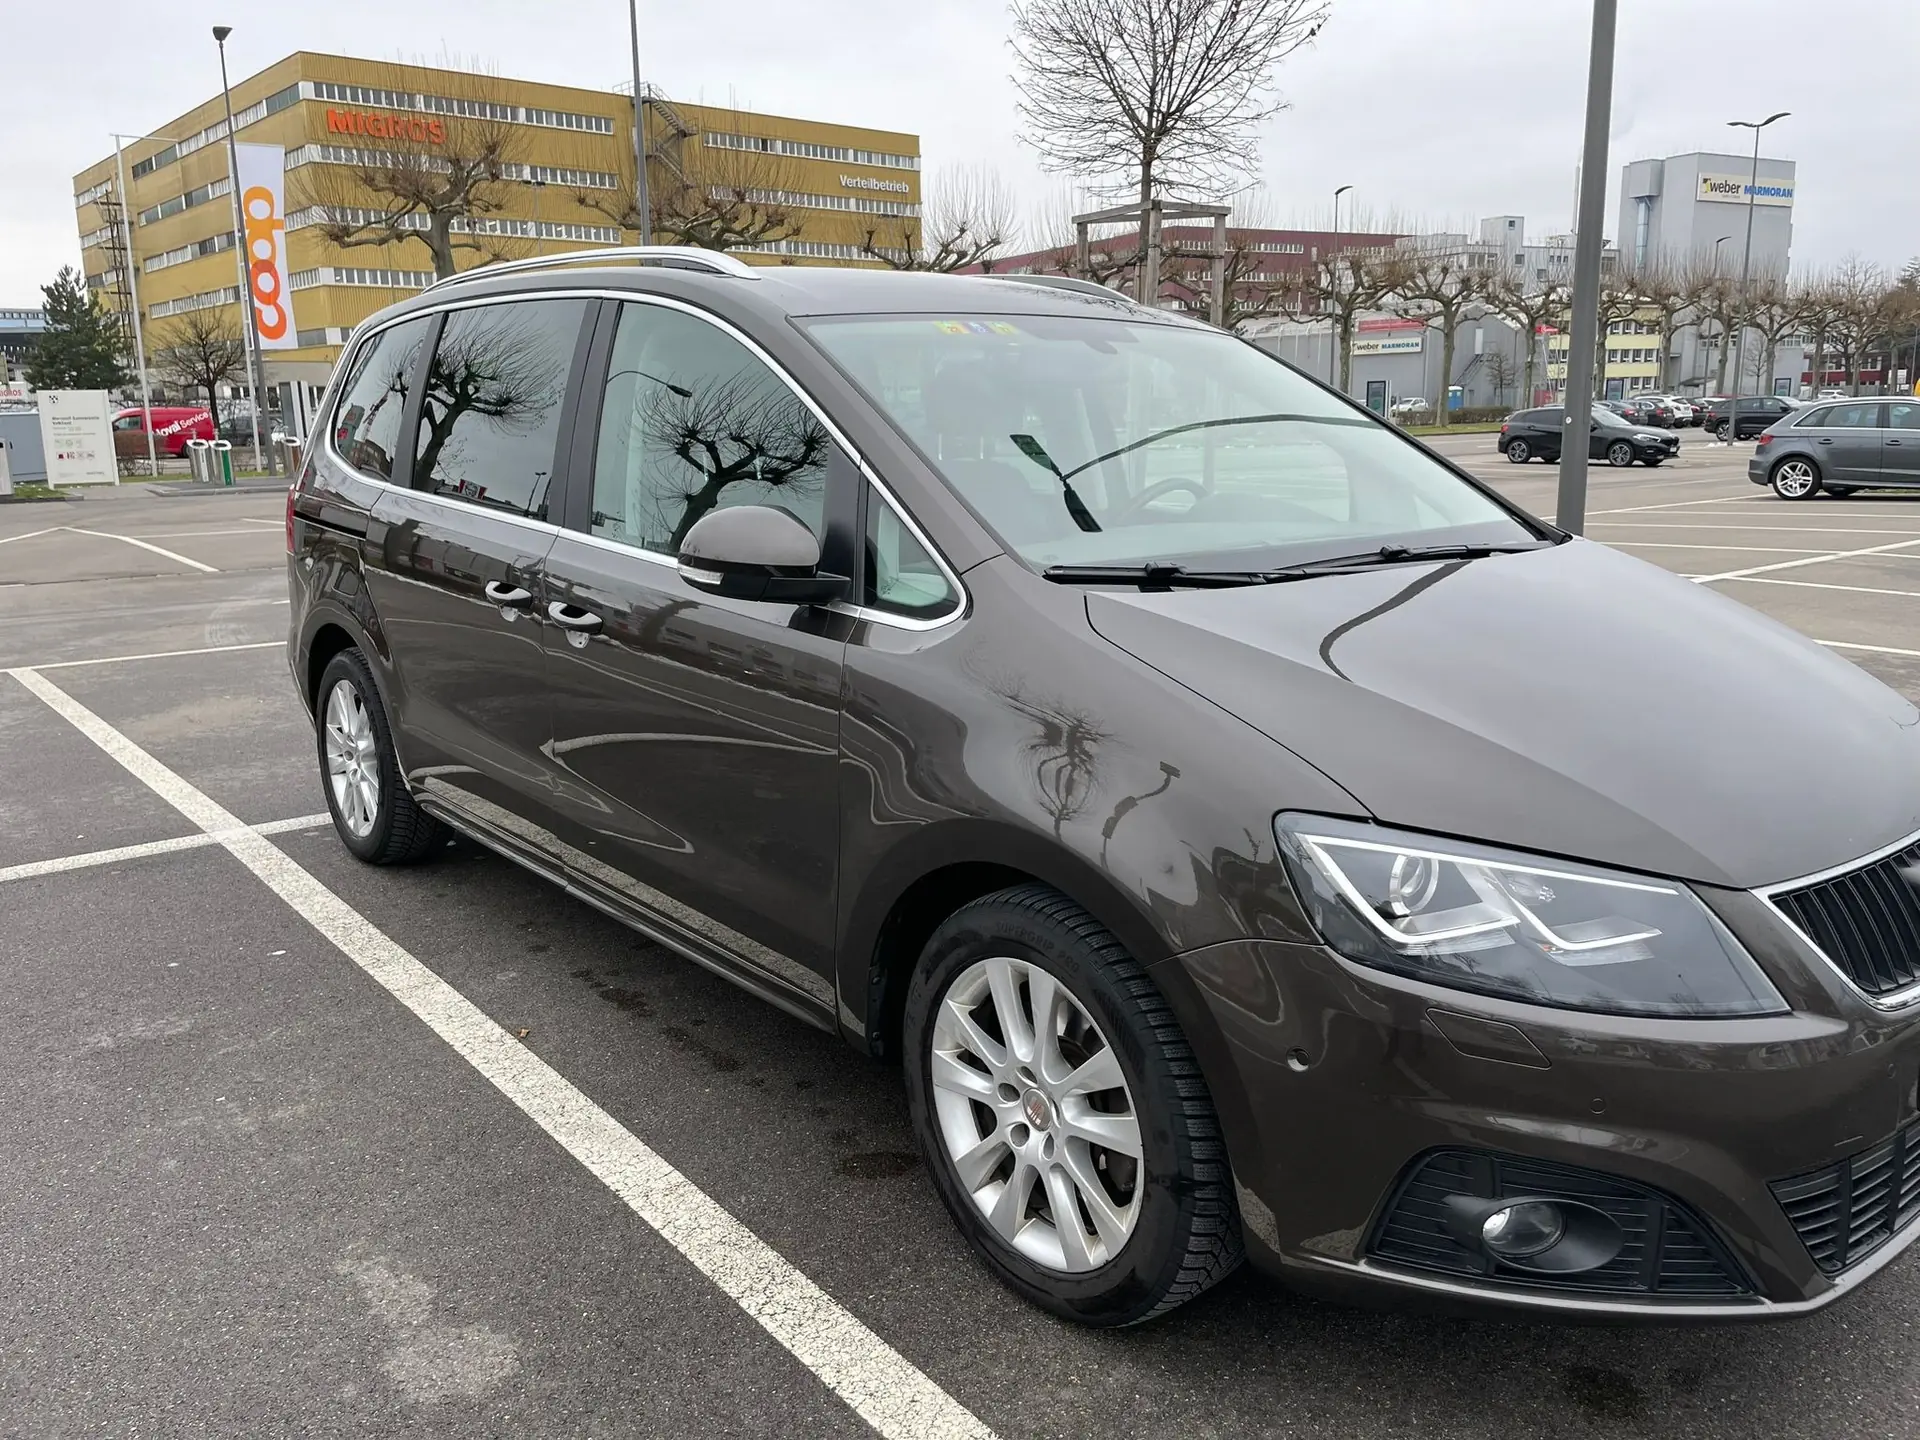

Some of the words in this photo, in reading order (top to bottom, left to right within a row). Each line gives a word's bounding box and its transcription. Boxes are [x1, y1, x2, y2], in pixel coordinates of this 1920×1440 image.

[327, 108, 446, 144] MIGROS
[839, 174, 909, 193] Verteilbetrieb
[1710, 180, 1741, 194] weber
[243, 186, 287, 340] coop
[1356, 342, 1379, 350] weber
[180, 412, 209, 428] Service
